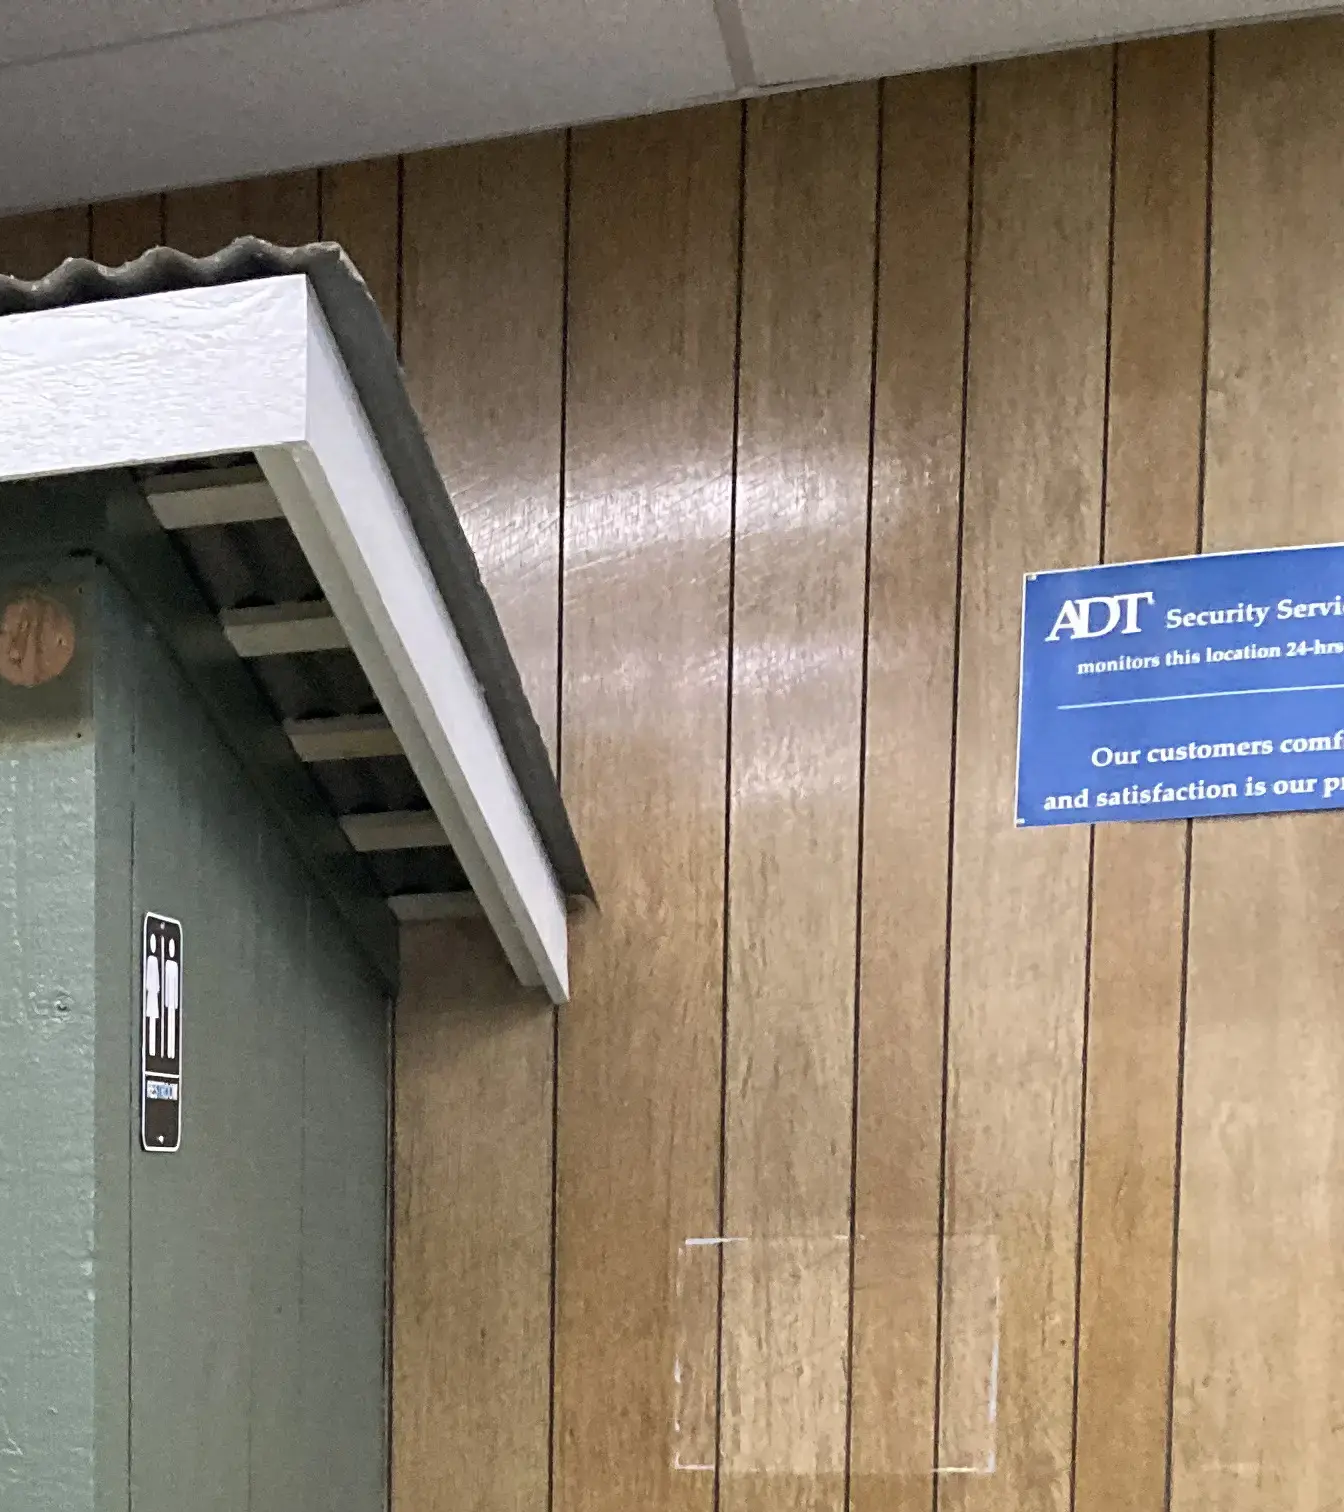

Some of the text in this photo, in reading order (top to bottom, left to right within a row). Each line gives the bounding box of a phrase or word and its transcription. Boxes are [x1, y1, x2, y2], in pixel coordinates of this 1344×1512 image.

[1045, 592, 1344, 642] ADT Security Servi
[1077, 653, 1160, 675] monitors
[1165, 650, 1200, 667] this
[1205, 643, 1281, 663] location
[1091, 729, 1344, 768] Our customers comf
[1043, 788, 1088, 811] and
[1096, 779, 1237, 808] satisfaction
[1244, 777, 1267, 797] is
[1273, 778, 1318, 795] our
